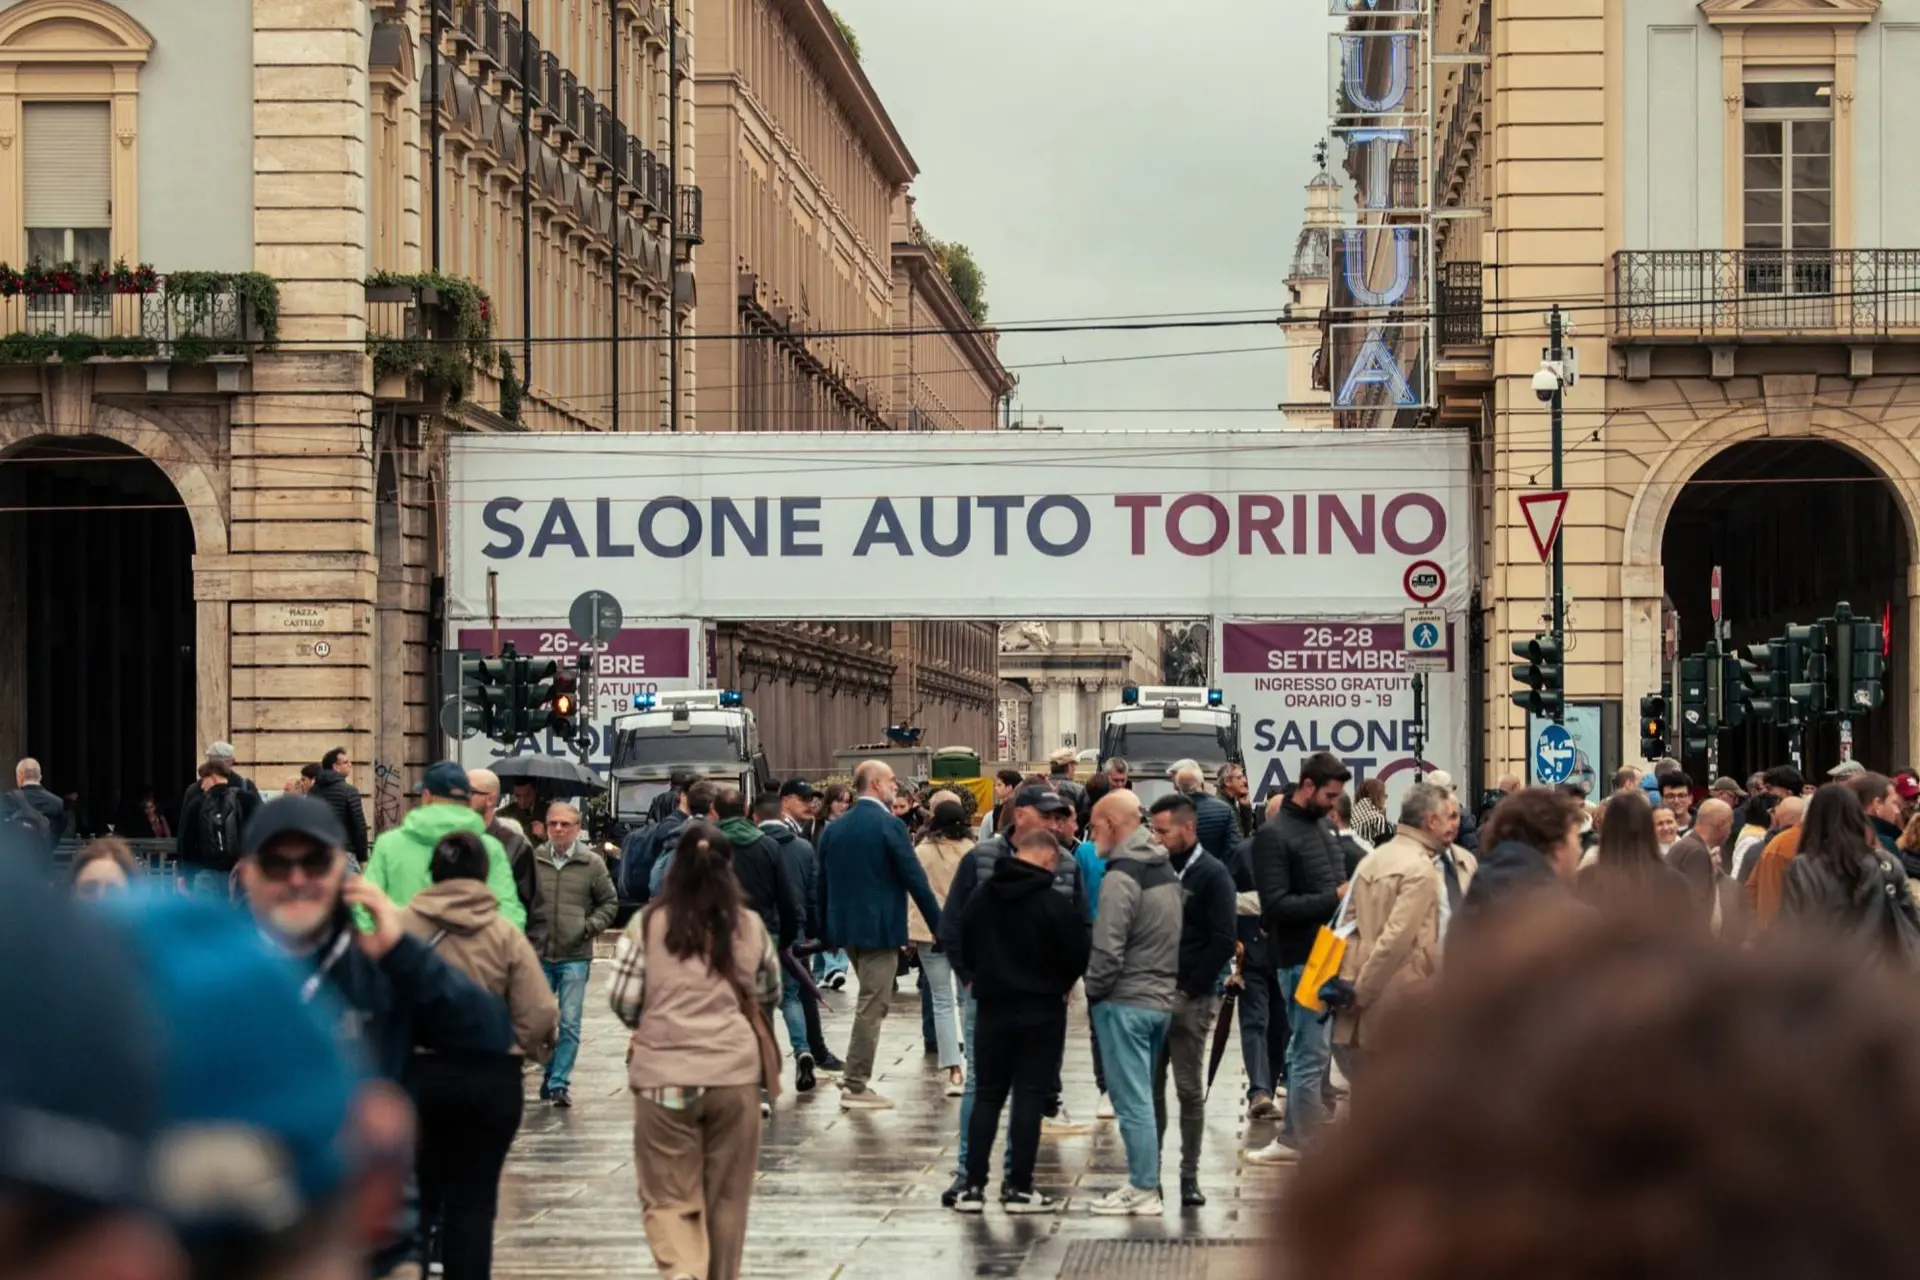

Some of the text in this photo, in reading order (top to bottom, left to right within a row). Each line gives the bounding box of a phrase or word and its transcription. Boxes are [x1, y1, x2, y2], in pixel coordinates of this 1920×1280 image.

[1330, 0, 1418, 406] UTUA
[481, 492, 1447, 560] SALONE AUTO TORINO
[284, 619, 325, 627] CASTELLO
[1303, 627, 1374, 648] 26-28
[1267, 650, 1410, 669] SETTEMBRE
[1254, 677, 1411, 691] INGRESSO GRATUIT
[611, 699, 628, 713] 19
[1284, 694, 1347, 708] ORARIO
[1350, 694, 1361, 708] 9
[1376, 694, 1393, 708] 19
[1253, 718, 1421, 752] SALONE
